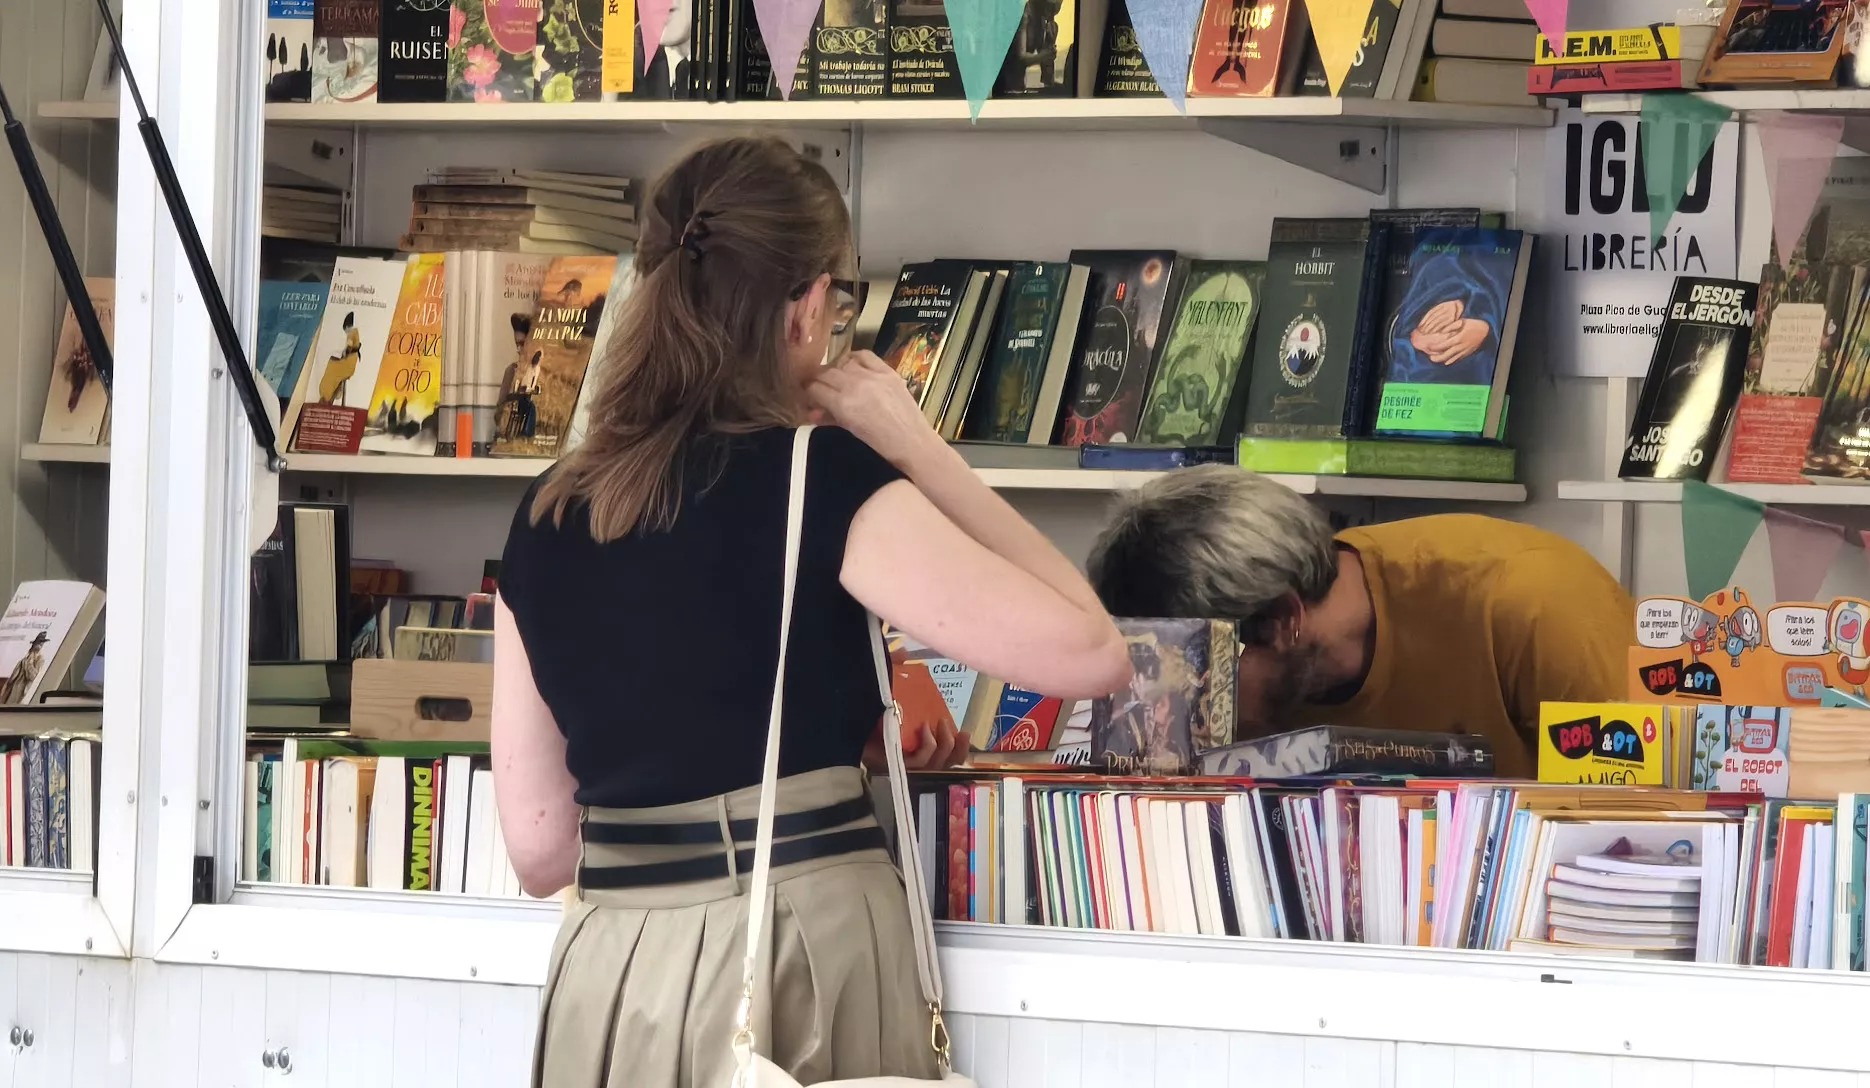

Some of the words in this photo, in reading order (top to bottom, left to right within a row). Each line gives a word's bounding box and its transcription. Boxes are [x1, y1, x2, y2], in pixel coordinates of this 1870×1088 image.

[431, 26, 443, 37] EL
[818, 85, 852, 94] THOMAS
[910, 83, 935, 93] STOKER
[1564, 227, 1707, 273] LIBRERÍA
[1294, 262, 1336, 276] HOBBIT
[940, 284, 951, 296] La
[1690, 284, 1745, 306] DESDE
[538, 307, 553, 323] LA
[557, 307, 587, 323] NOVIA
[1580, 304, 1603, 315] Plaza
[1606, 304, 1625, 315] Pico
[1628, 304, 1640, 315] de
[1671, 302, 1688, 320] EL
[532, 327, 545, 340] DE
[547, 328, 559, 340] LA
[560, 325, 585, 341] PAZ
[394, 368, 431, 394] ORO
[1381, 409, 1394, 420] DE
[1395, 409, 1413, 420] FEZ
[1643, 426, 1669, 444] JOS
[1629, 444, 1703, 467] SANTGO
[1663, 608, 1672, 617] los
[1804, 615, 1816, 624] los
[1640, 620, 1650, 629] que
[1786, 627, 1799, 636] que
[1650, 631, 1655, 639] a
[1648, 666, 1677, 690] ROB
[1559, 723, 1593, 753] ROB
[1725, 758, 1739, 773] EL
[1742, 759, 1783, 774] ROBOT
[1740, 778, 1763, 793] DEL
[409, 766, 432, 890] DINNIMA
